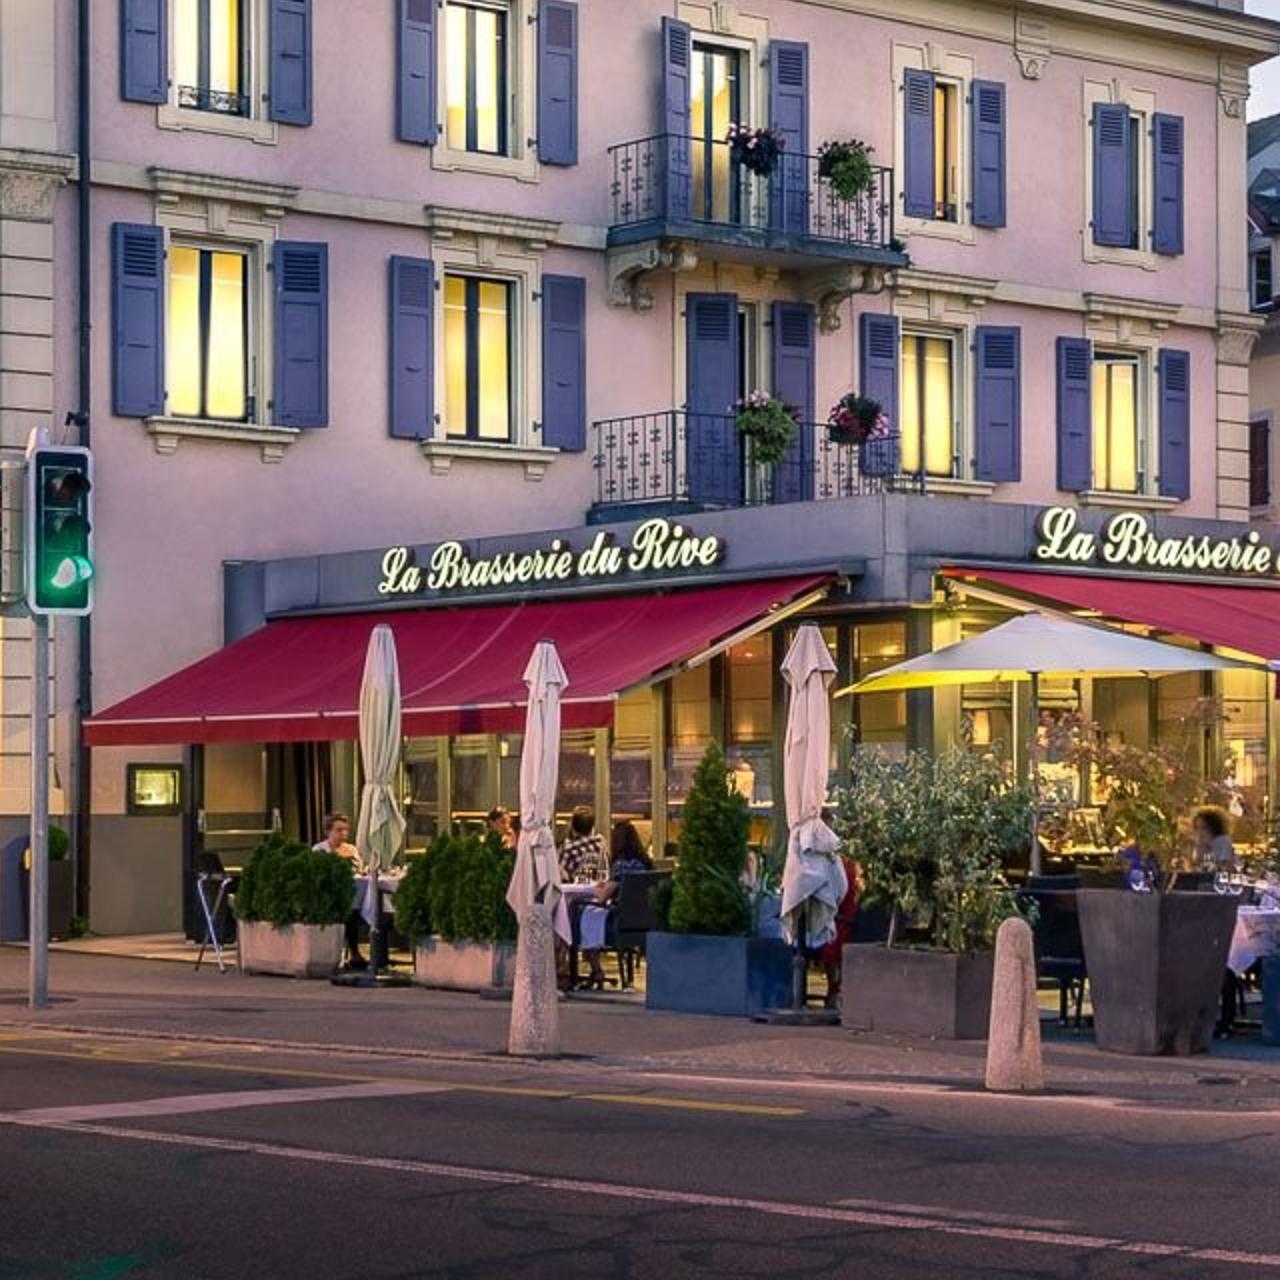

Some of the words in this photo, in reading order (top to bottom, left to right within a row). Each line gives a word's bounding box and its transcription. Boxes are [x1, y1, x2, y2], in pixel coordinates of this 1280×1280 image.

[377, 545, 420, 593] La
[426, 538, 572, 589] Brasserie
[577, 531, 622, 576] du
[627, 517, 718, 570] Rive
[1036, 506, 1095, 561] La
[1102, 511, 1271, 574] Brasserie
